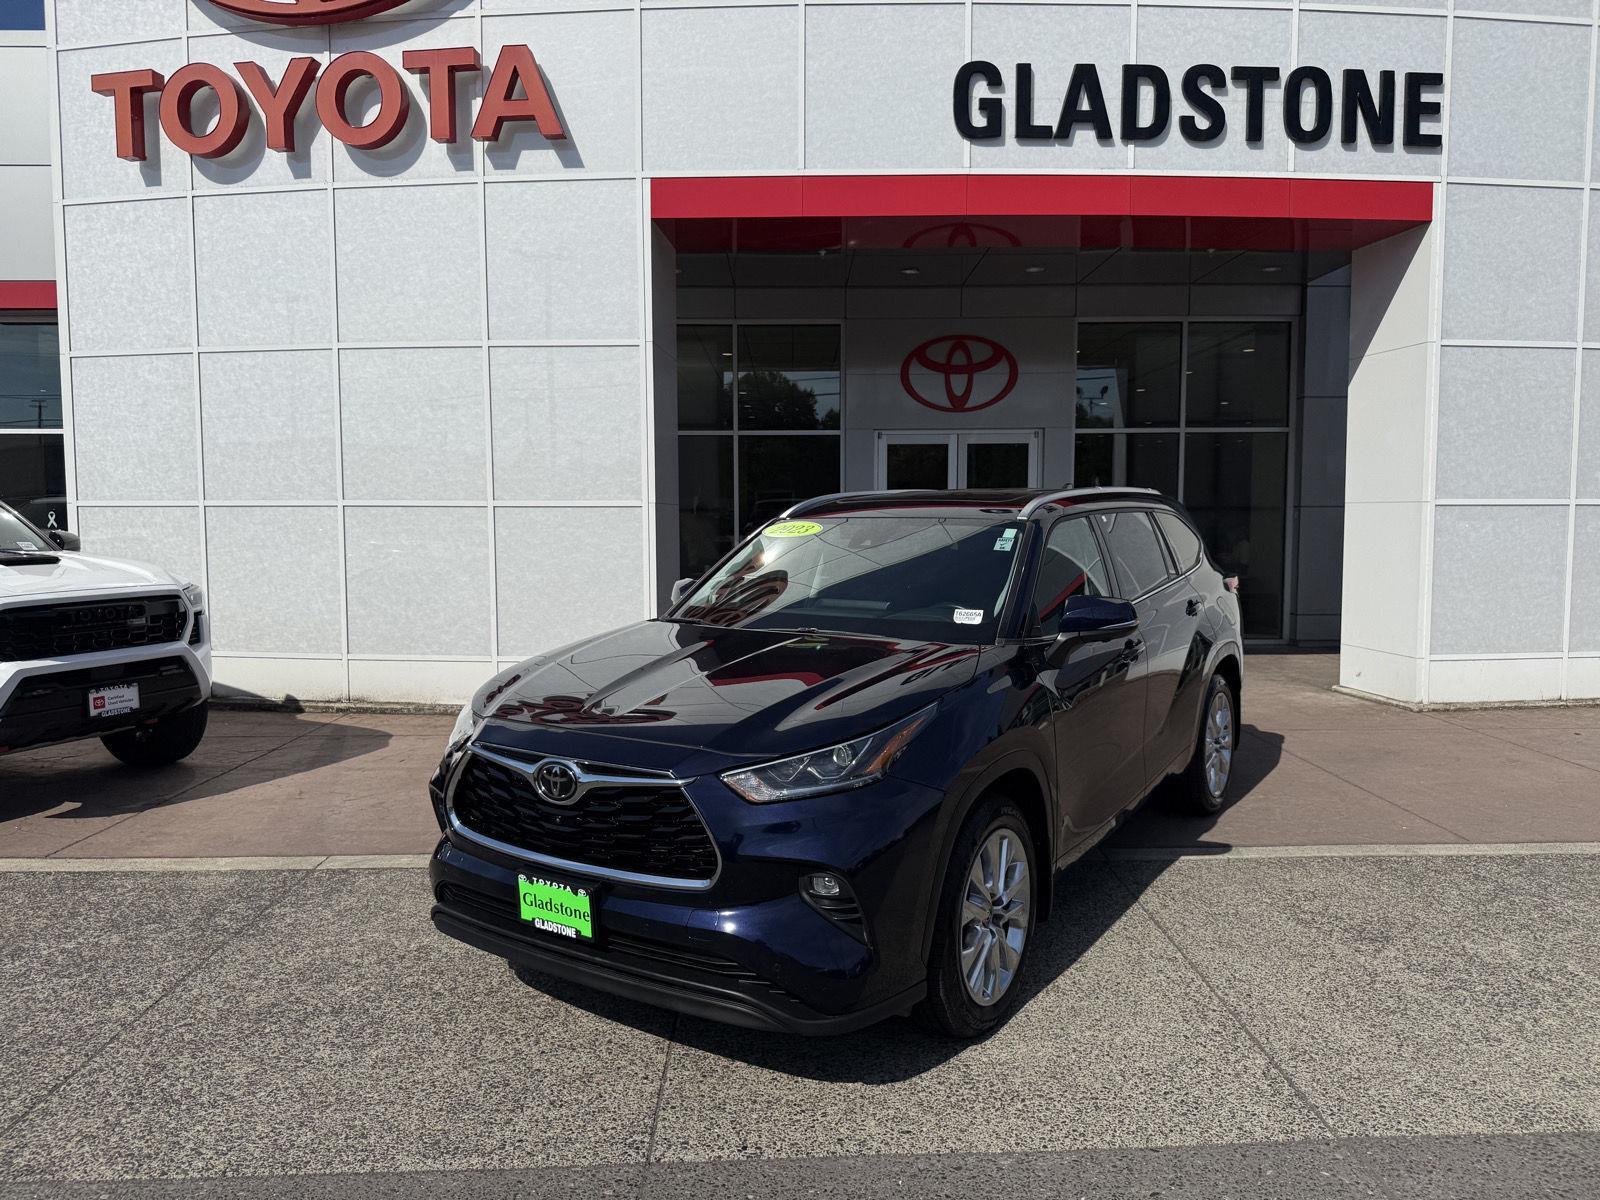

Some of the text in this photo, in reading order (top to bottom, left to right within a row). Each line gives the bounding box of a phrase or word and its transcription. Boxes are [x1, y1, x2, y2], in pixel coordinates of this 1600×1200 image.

[91, 44, 567, 162] TOYOTA
[952, 60, 1444, 148] GLADSTONE
[767, 525, 816, 534] 2023
[101, 707, 131, 717] GLADSTONE
[532, 876, 572, 893] TOYOTA
[522, 892, 590, 922] Gladstone
[534, 917, 577, 938] GLADSTONE
